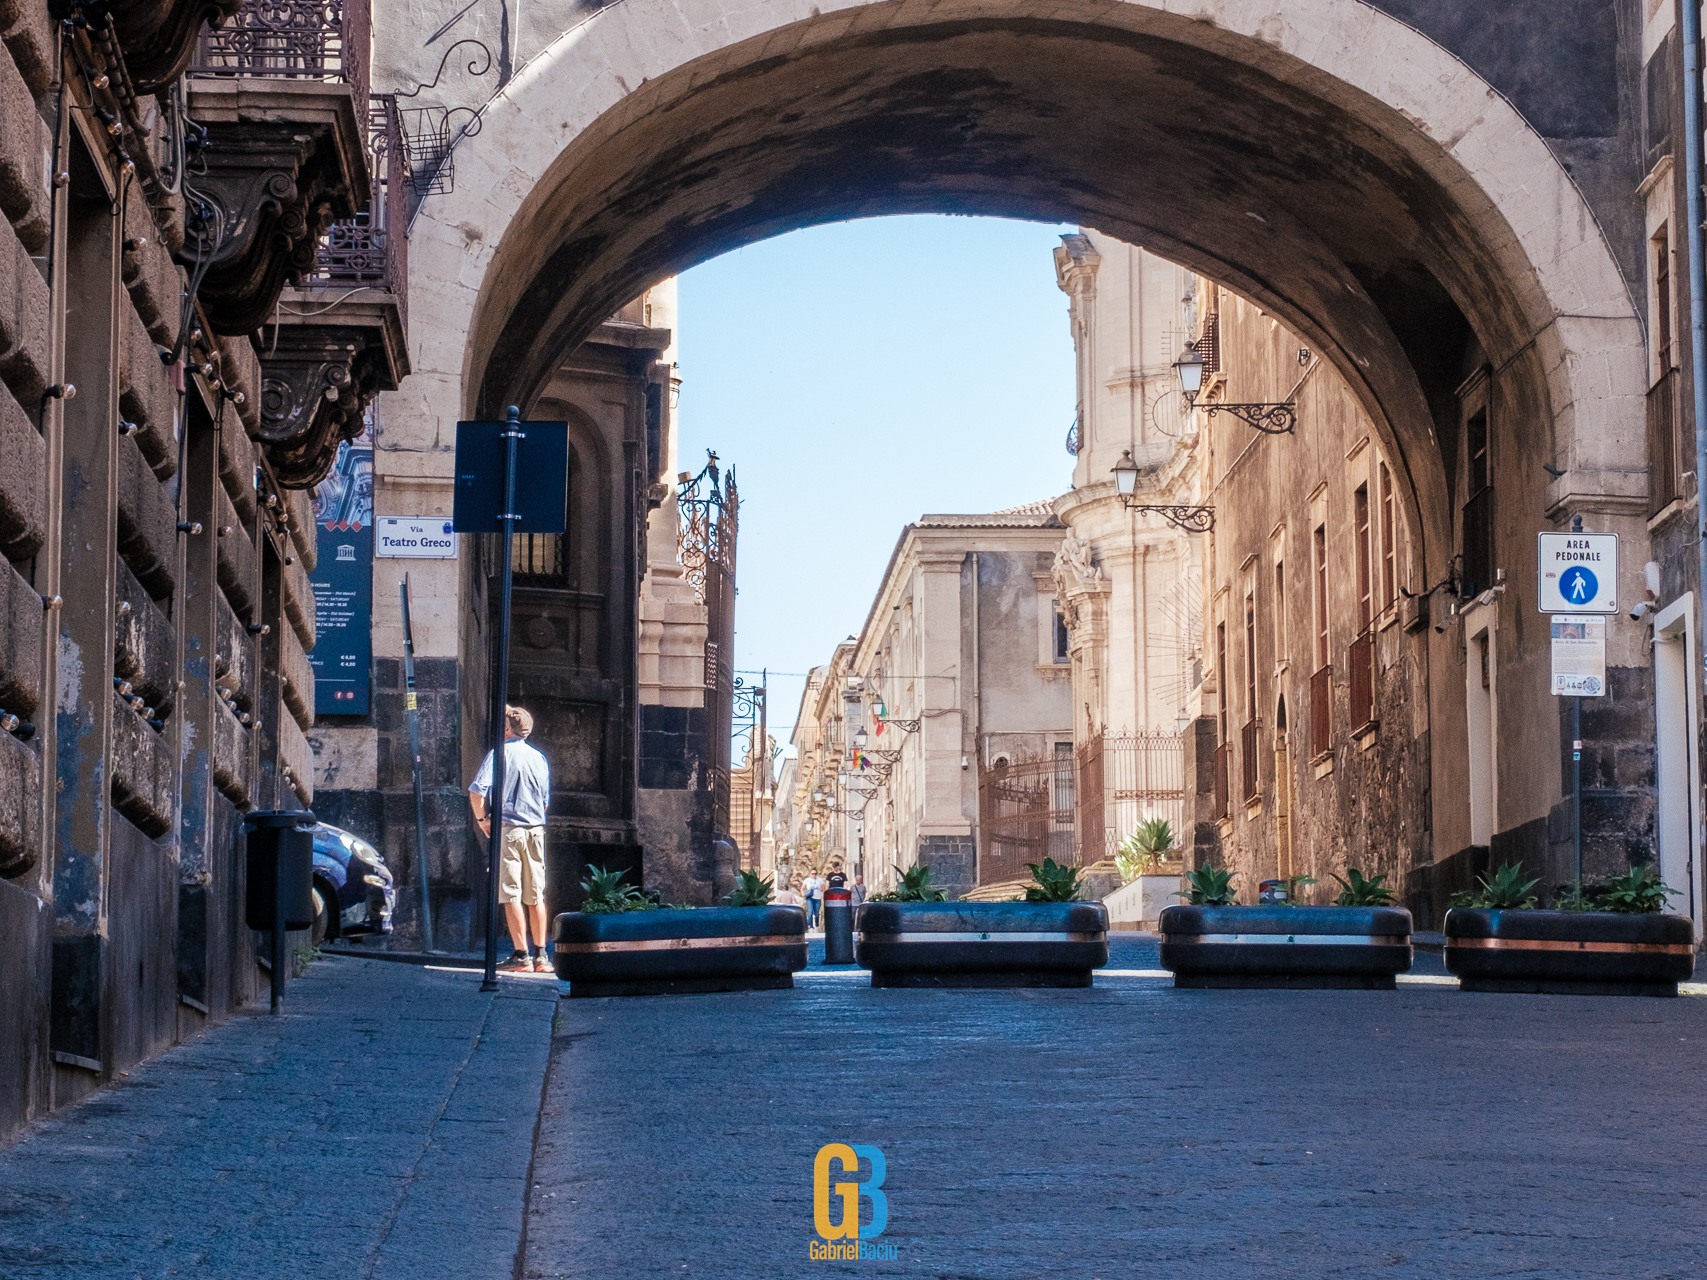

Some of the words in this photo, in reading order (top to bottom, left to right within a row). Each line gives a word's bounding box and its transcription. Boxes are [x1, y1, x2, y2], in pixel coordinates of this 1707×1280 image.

[382, 536, 418, 547] Teatro
[420, 537, 452, 548] Greco
[1566, 540, 1591, 549] AREA
[1555, 552, 1602, 562] PEDONALE
